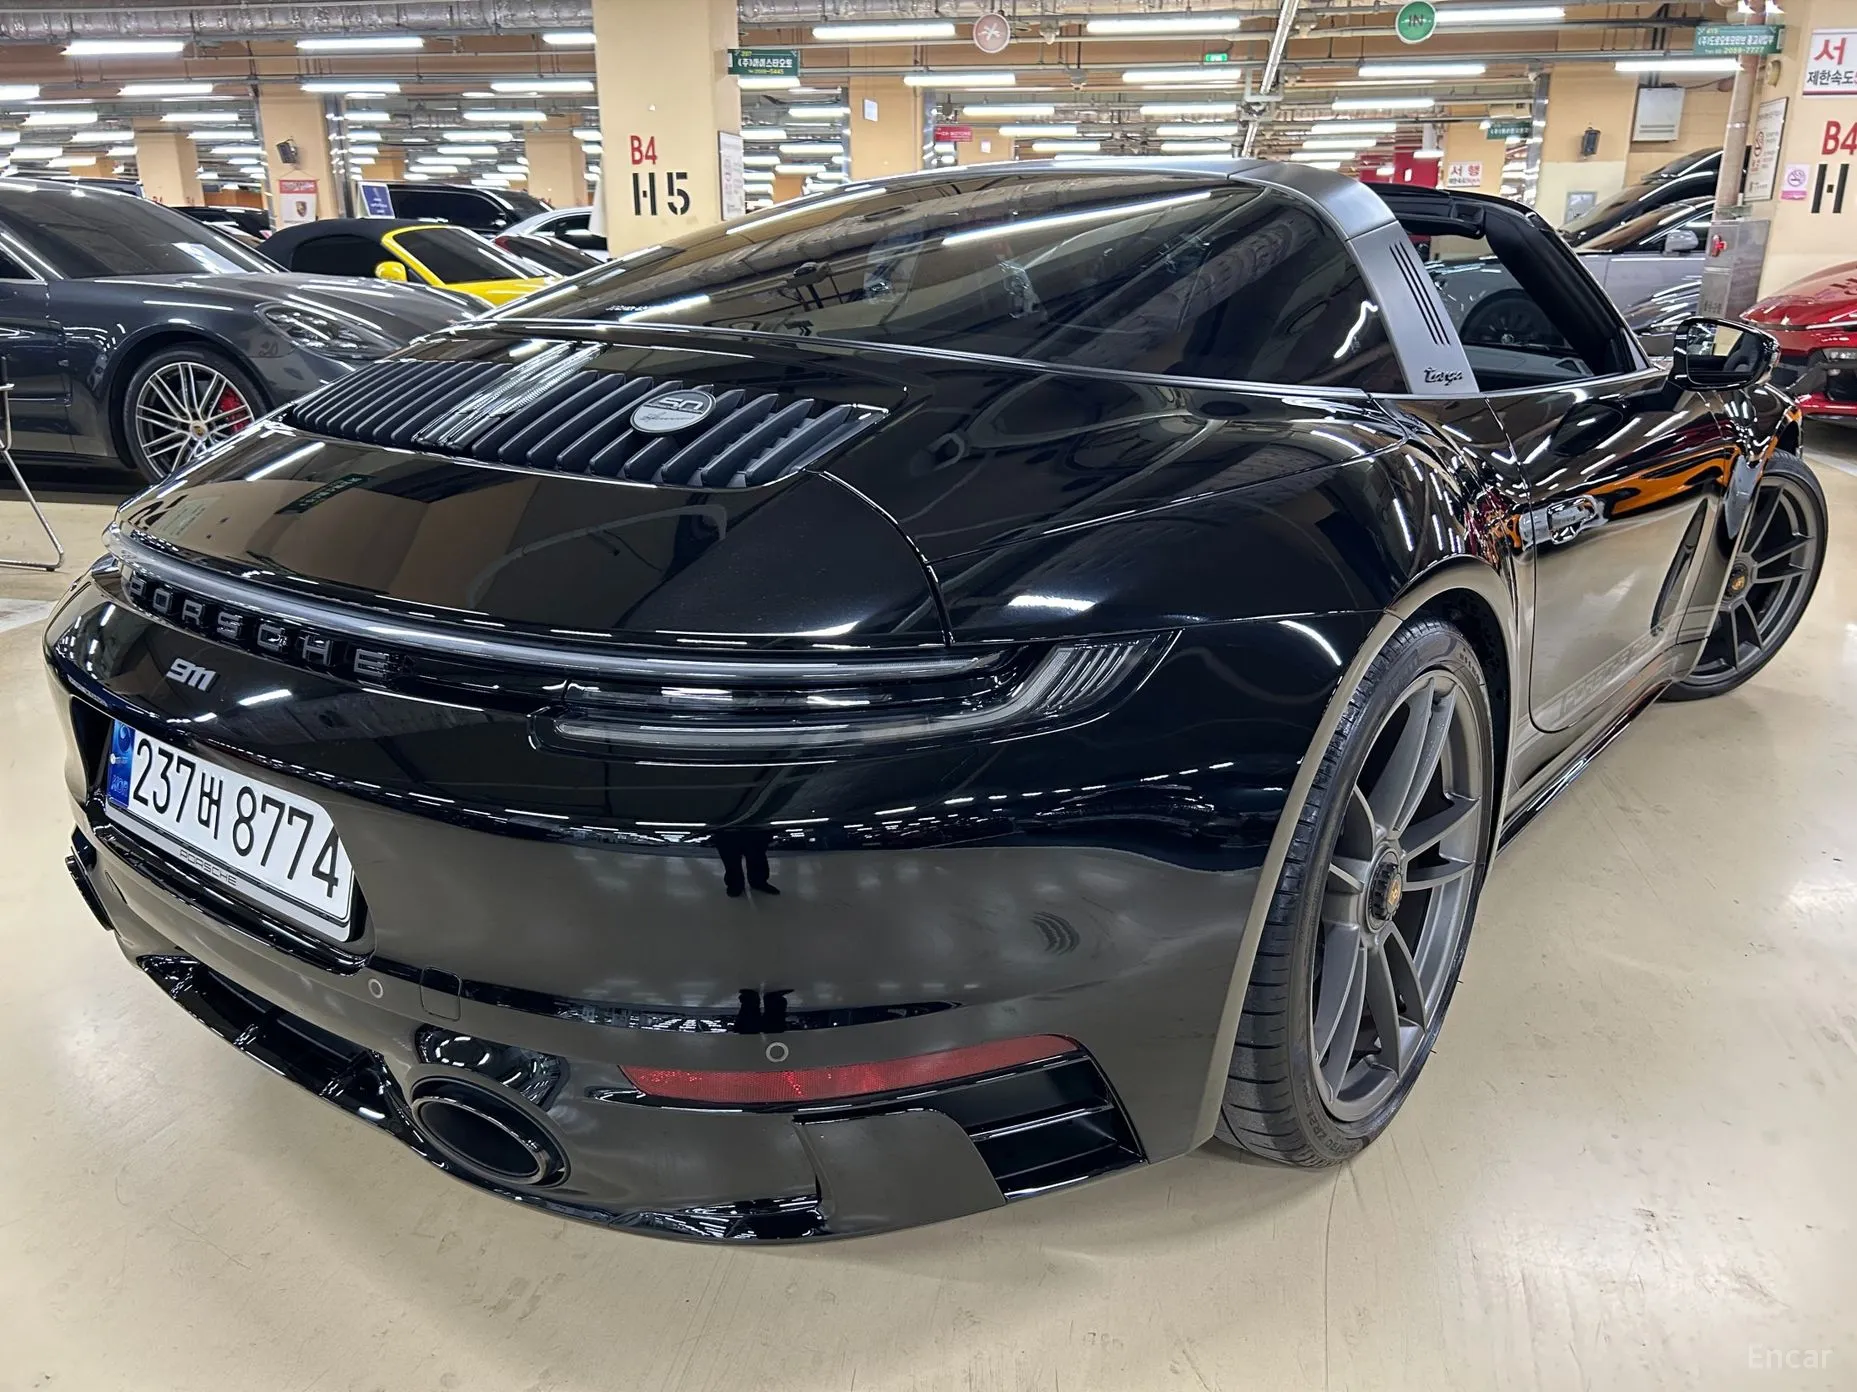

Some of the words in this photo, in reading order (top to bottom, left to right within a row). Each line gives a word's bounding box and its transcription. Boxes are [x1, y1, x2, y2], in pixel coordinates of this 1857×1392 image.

[1408, 14, 1424, 27] IN
[1813, 37, 1847, 65] 서
[1806, 69, 1857, 86] 제한속도
[630, 135, 658, 165] B4
[1821, 120, 1857, 155] B4
[129, 574, 390, 679] PORSCHE
[166, 657, 220, 692] 911
[132, 737, 224, 841] 237버
[232, 785, 340, 899] 8774
[179, 849, 238, 887] PORSCHE
